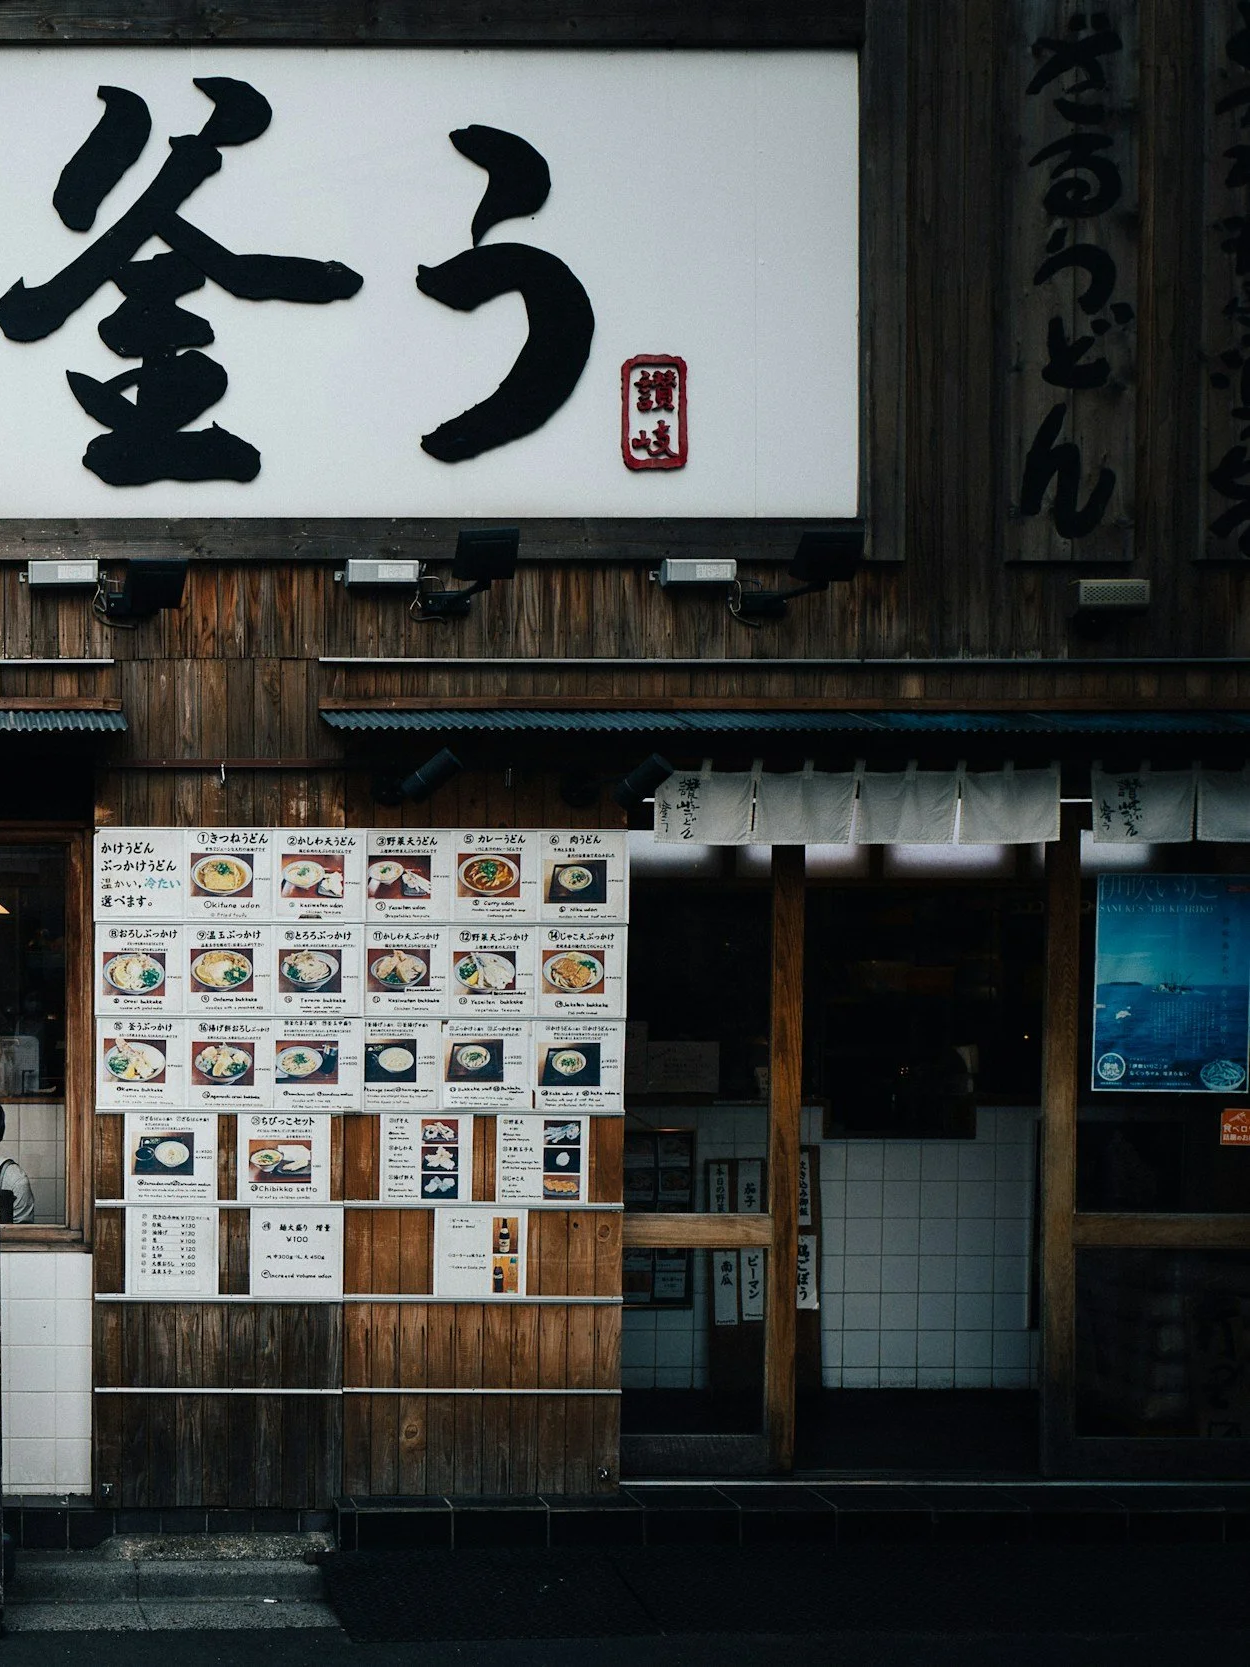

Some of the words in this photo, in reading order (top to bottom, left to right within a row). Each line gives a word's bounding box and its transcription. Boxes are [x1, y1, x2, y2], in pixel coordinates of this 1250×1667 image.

[1020, 11, 1136, 540] ざるうどん
[478, 834, 526, 844] カレーうどん
[570, 835, 602, 845] 肉うどん
[101, 842, 154, 855] かけうどん
[101, 859, 177, 872] ぶっかけうどん
[241, 901, 261, 909] udon
[127, 1022, 173, 1032] 釜うぶっかけ
[720, 1261, 733, 1286] 南瓜
[748, 1255, 760, 1299] ピーマン
